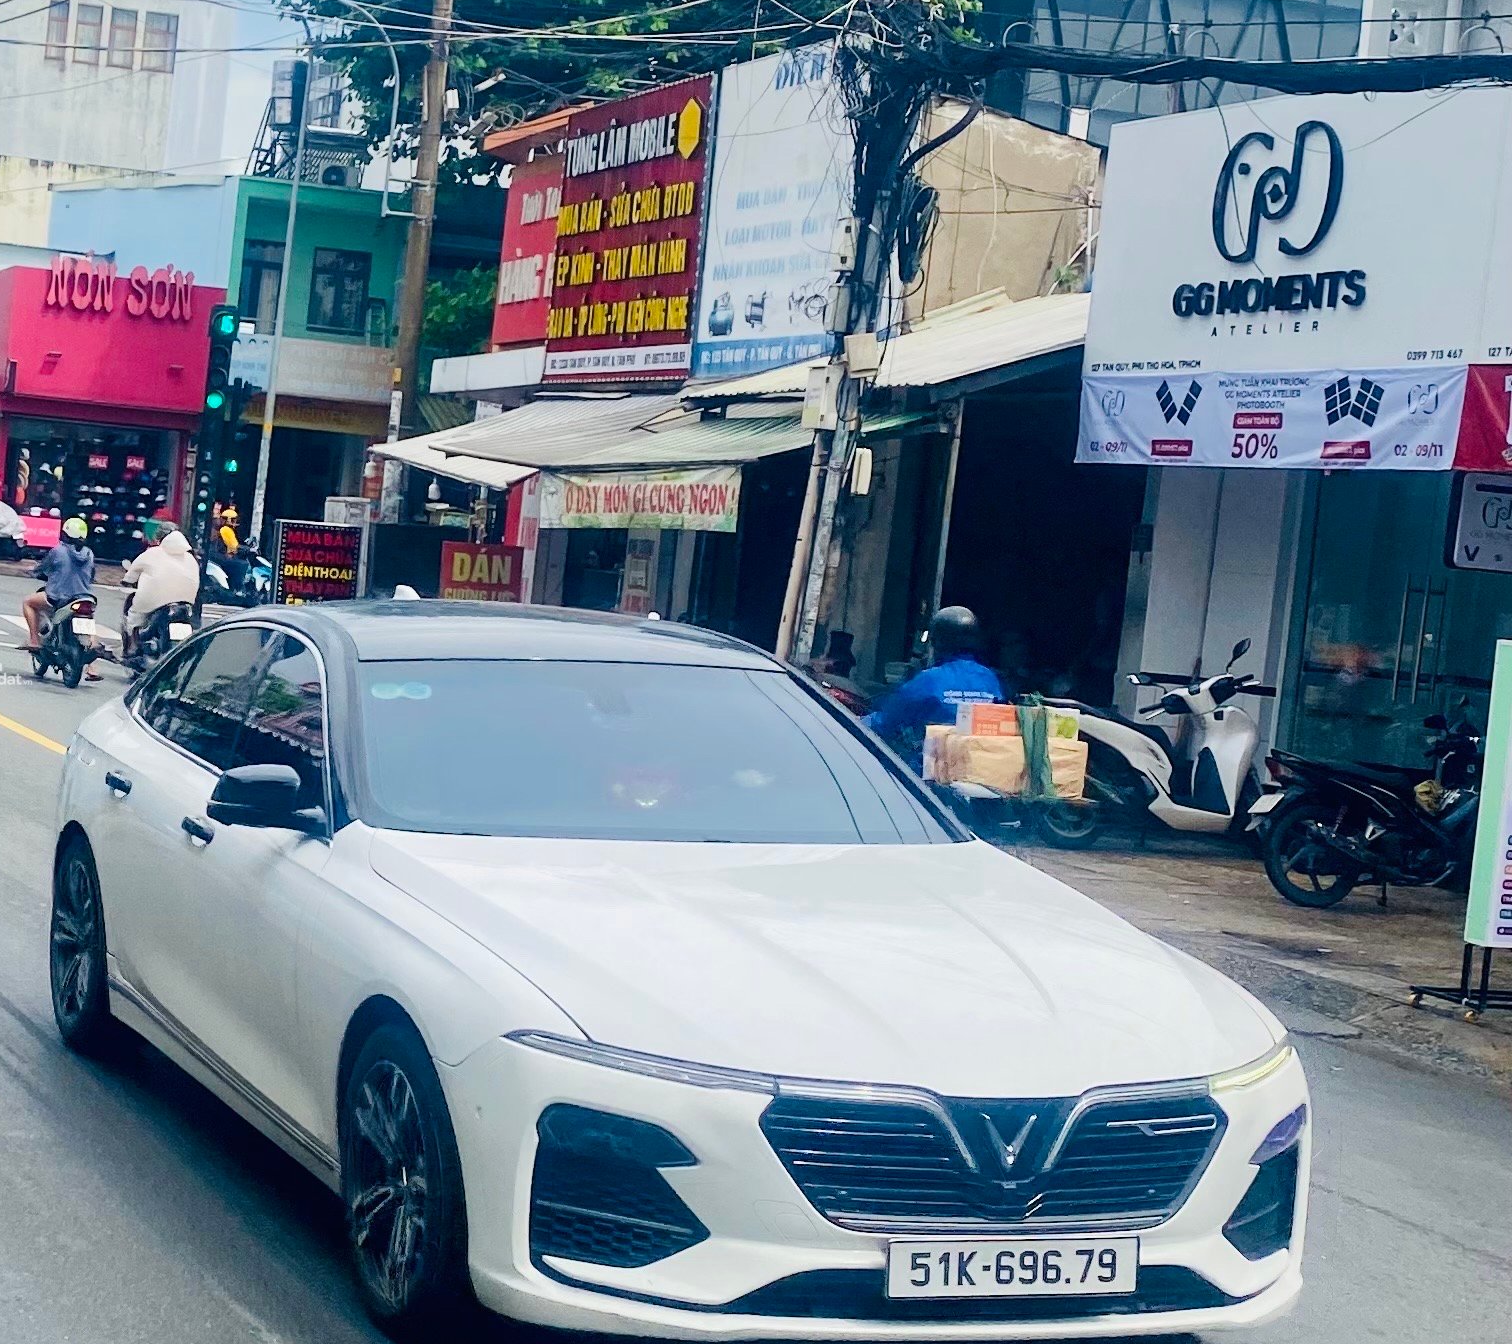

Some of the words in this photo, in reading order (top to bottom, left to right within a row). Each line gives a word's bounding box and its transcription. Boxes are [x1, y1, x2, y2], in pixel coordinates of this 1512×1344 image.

[597, 118, 627, 170] LÂM
[627, 112, 677, 164] MOBILE
[557, 205, 579, 236] MUA
[580, 193, 602, 233] BÁN
[46, 249, 117, 313] NÓN
[127, 263, 195, 321] SƠN
[1173, 283, 1215, 317] GG
[1216, 269, 1367, 315] MOMENTS
[1211, 320, 1319, 337] ATELIER
[1407, 350, 1427, 361] 0399
[1431, 349, 1444, 359] 713
[1447, 348, 1463, 359] 467
[1236, 389, 1270, 399] MOMENTS
[1272, 389, 1301, 398] ATELIER
[1236, 400, 1285, 410] PHOTOBOOTH
[1090, 441, 1099, 452] 02
[1231, 432, 1278, 460] 50%
[1394, 444, 1407, 456] 02
[1416, 442, 1443, 457] 09/11
[689, 483, 729, 515] NGON
[451, 548, 512, 585] DÁN
[910, 1248, 1118, 1288] 51K-696.79
